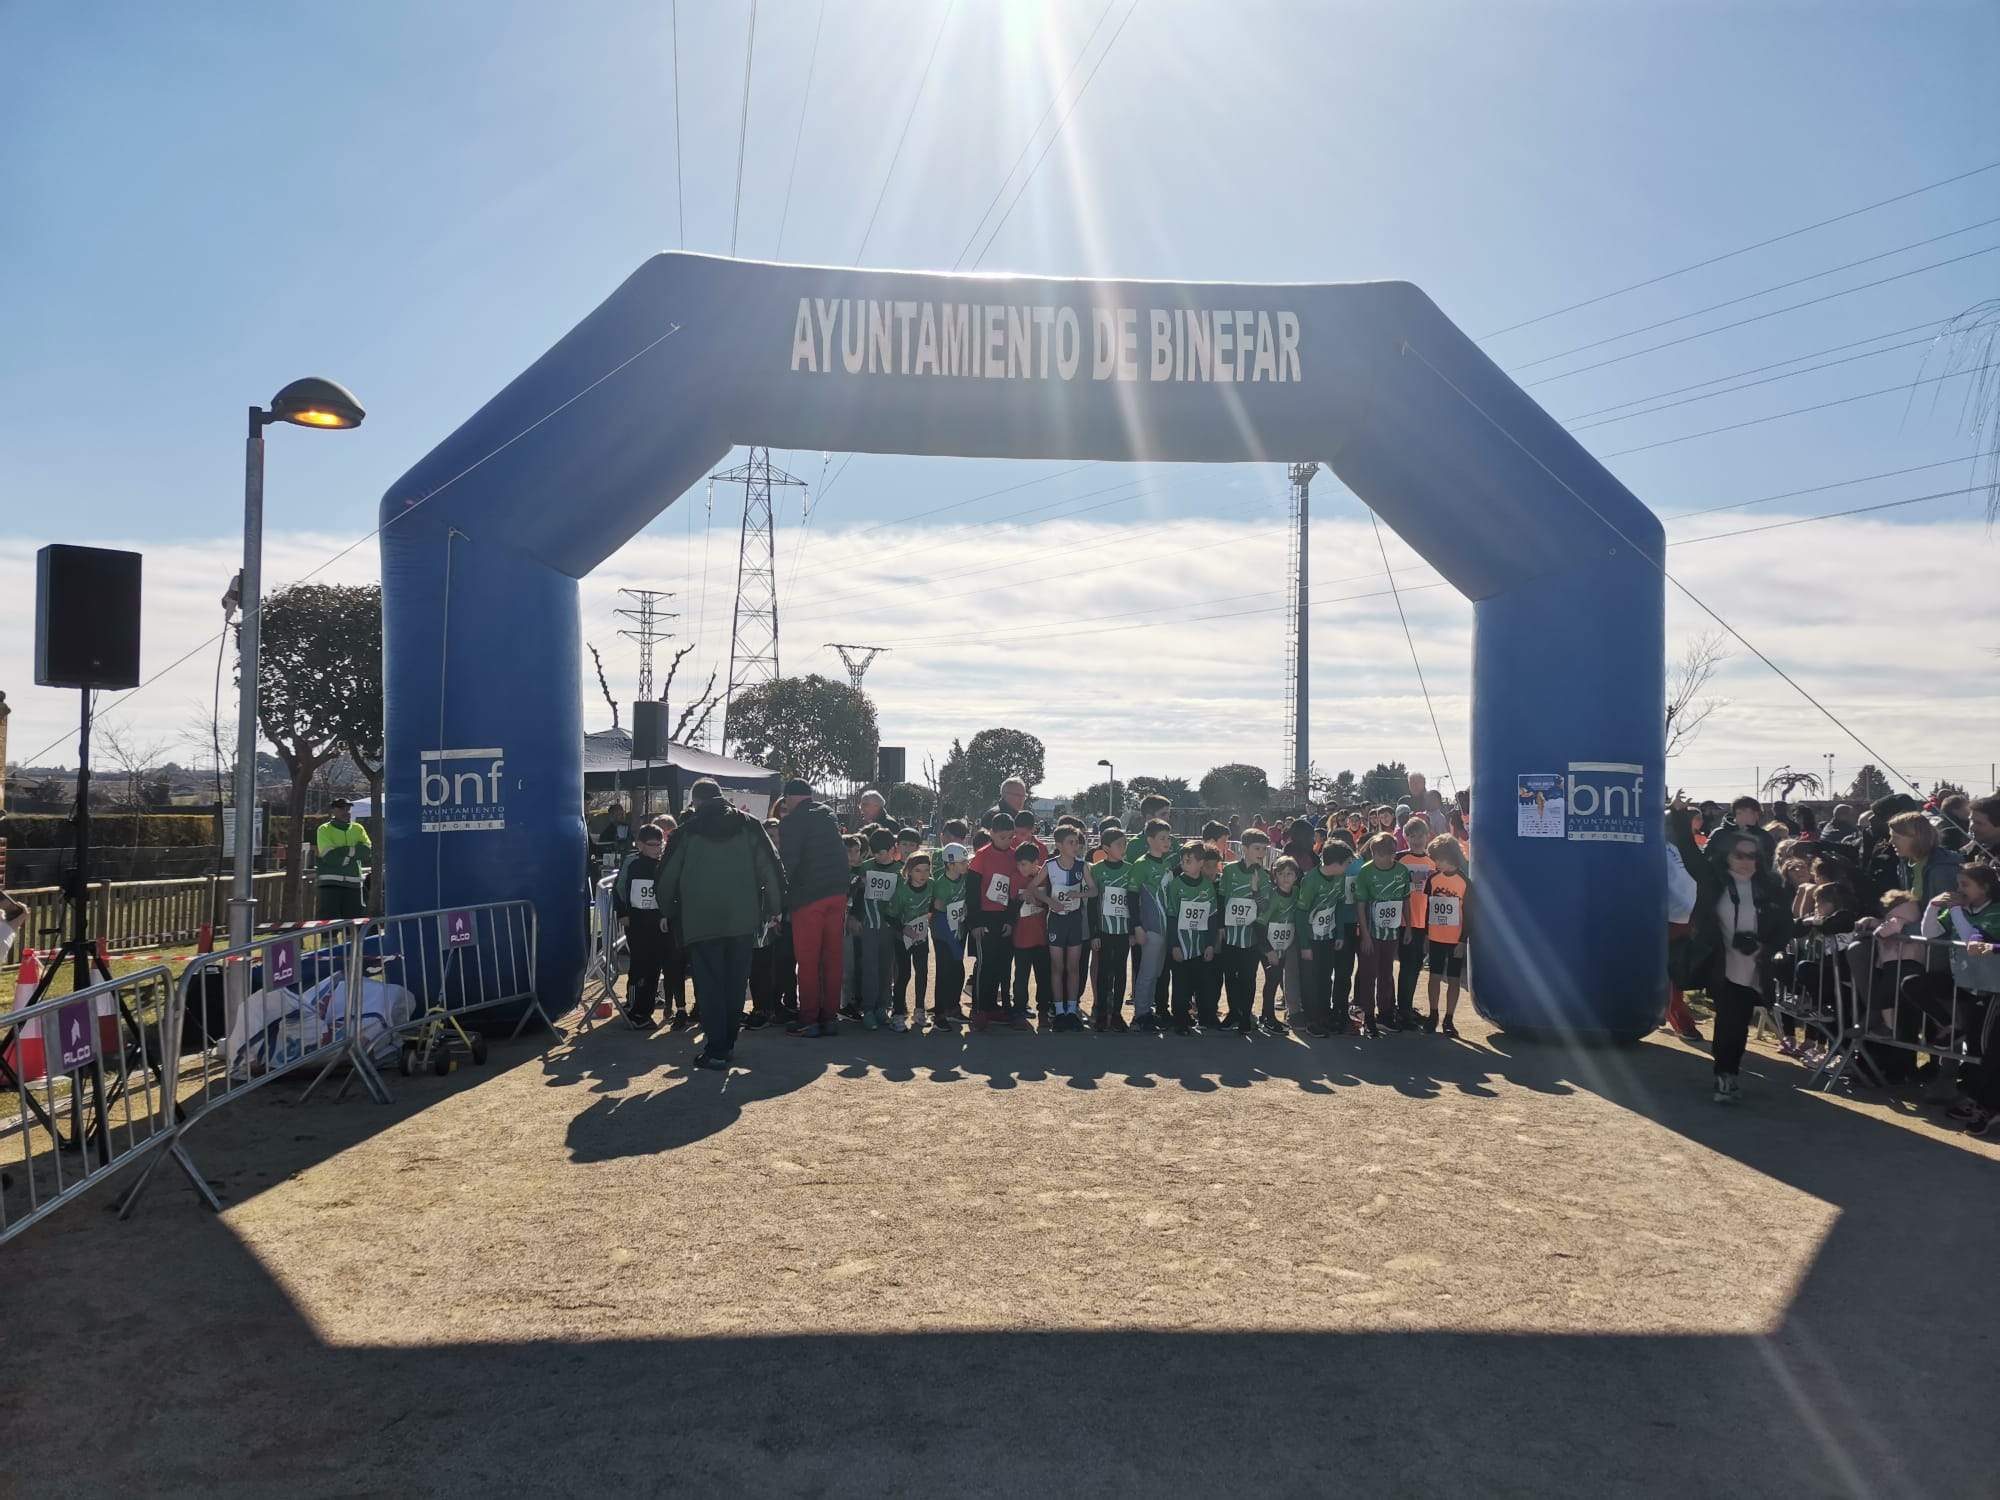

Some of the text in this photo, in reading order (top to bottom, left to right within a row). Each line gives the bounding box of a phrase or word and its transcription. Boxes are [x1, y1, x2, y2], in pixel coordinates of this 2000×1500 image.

[790, 297, 1302, 382] AYUNTAMIENTO DE BINEFAR
[421, 760, 504, 806] bnf
[1568, 774, 1643, 817] bnf
[870, 877, 891, 890] 990
[995, 881, 1009, 893] 96
[640, 886, 655, 898] 99
[1185, 908, 1206, 920] 987
[1231, 904, 1252, 917] 997
[1379, 907, 1397, 919] 988
[1434, 903, 1453, 914] 909
[1273, 929, 1292, 941] 989
[63, 1044, 91, 1065] ALCO
